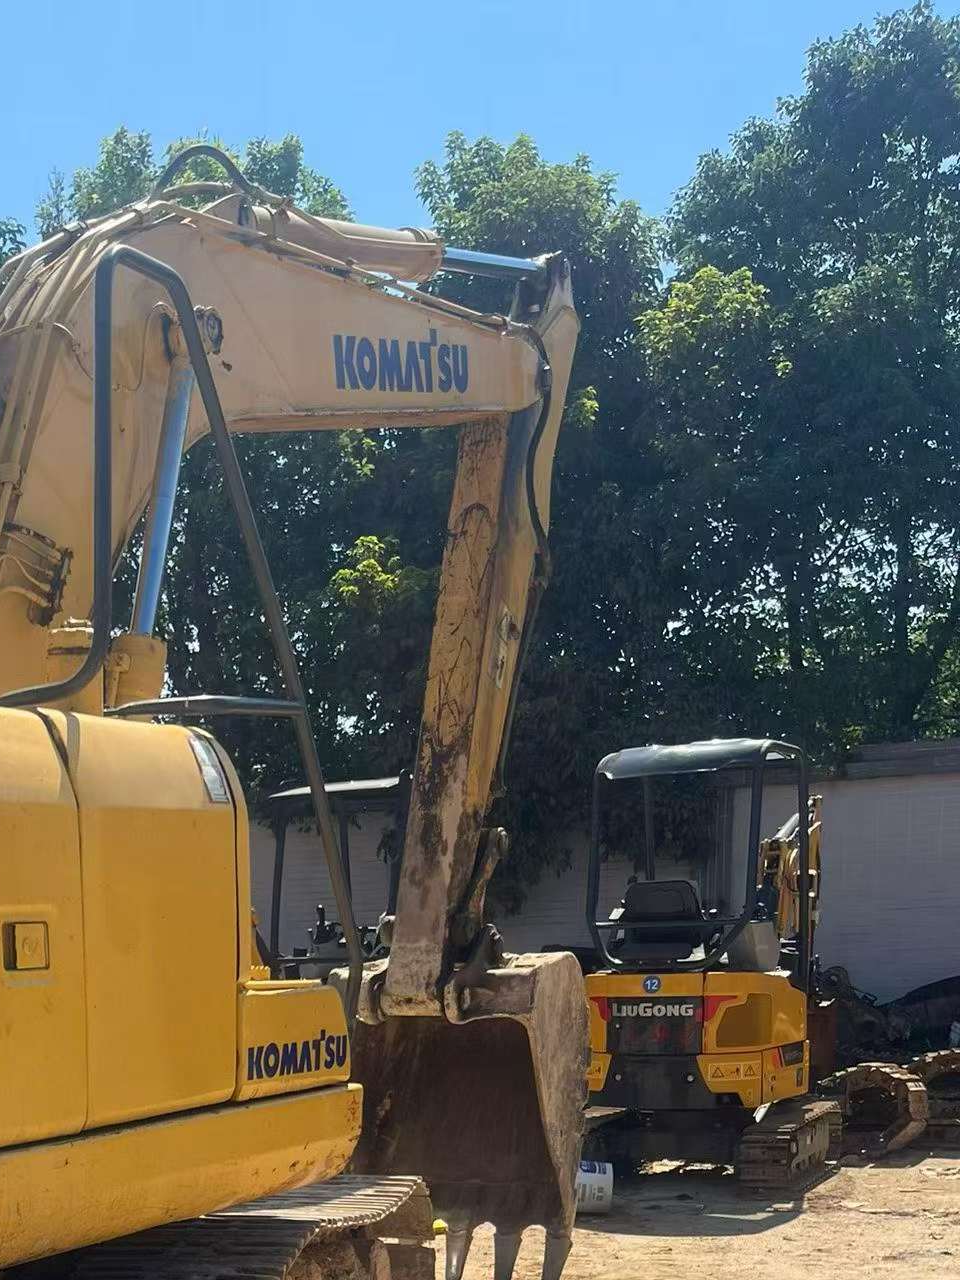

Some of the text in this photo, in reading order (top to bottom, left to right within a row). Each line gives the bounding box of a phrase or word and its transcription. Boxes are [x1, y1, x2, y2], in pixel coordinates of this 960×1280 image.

[333, 328, 469, 394] KOMATSU
[645, 979, 659, 990] 12
[247, 1029, 348, 1081] KOMATSU
